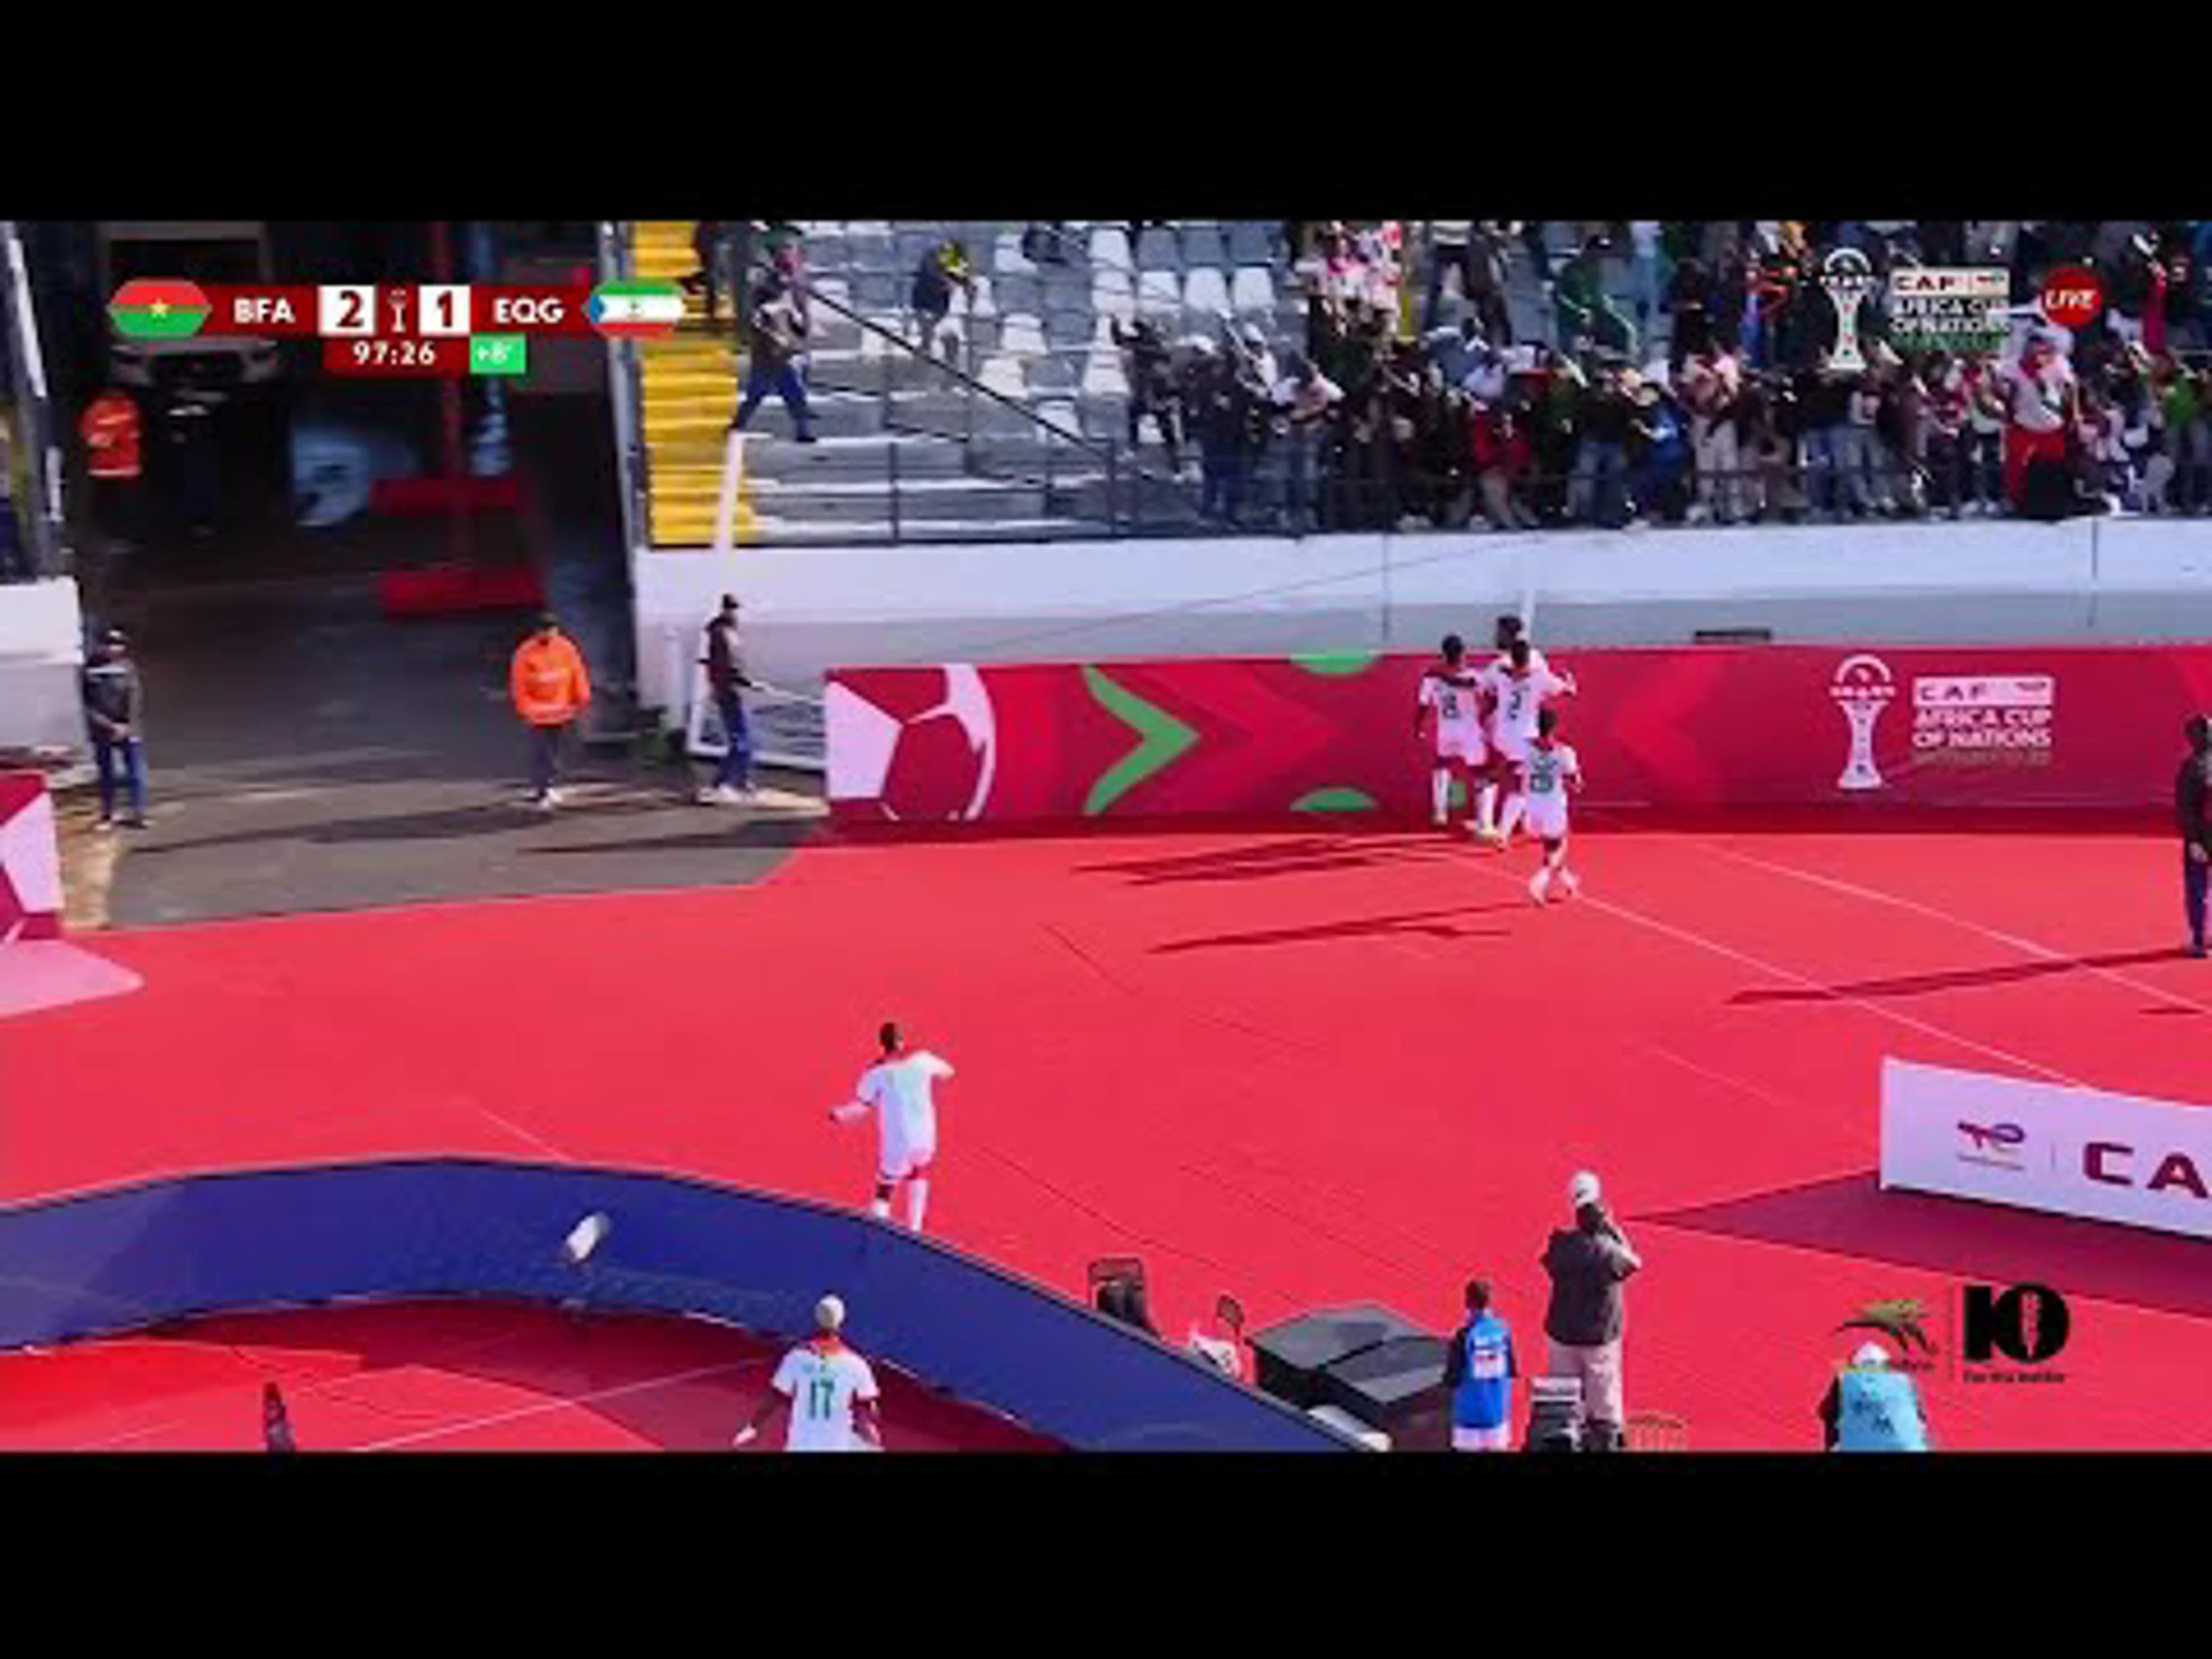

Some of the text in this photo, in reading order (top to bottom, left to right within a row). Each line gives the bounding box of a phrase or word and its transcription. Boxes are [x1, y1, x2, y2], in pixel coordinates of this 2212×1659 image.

[1915, 709, 2052, 726] AFRICA CUP
[1912, 729, 2052, 748] OF NATIONS
[810, 1378, 835, 1419] 17
